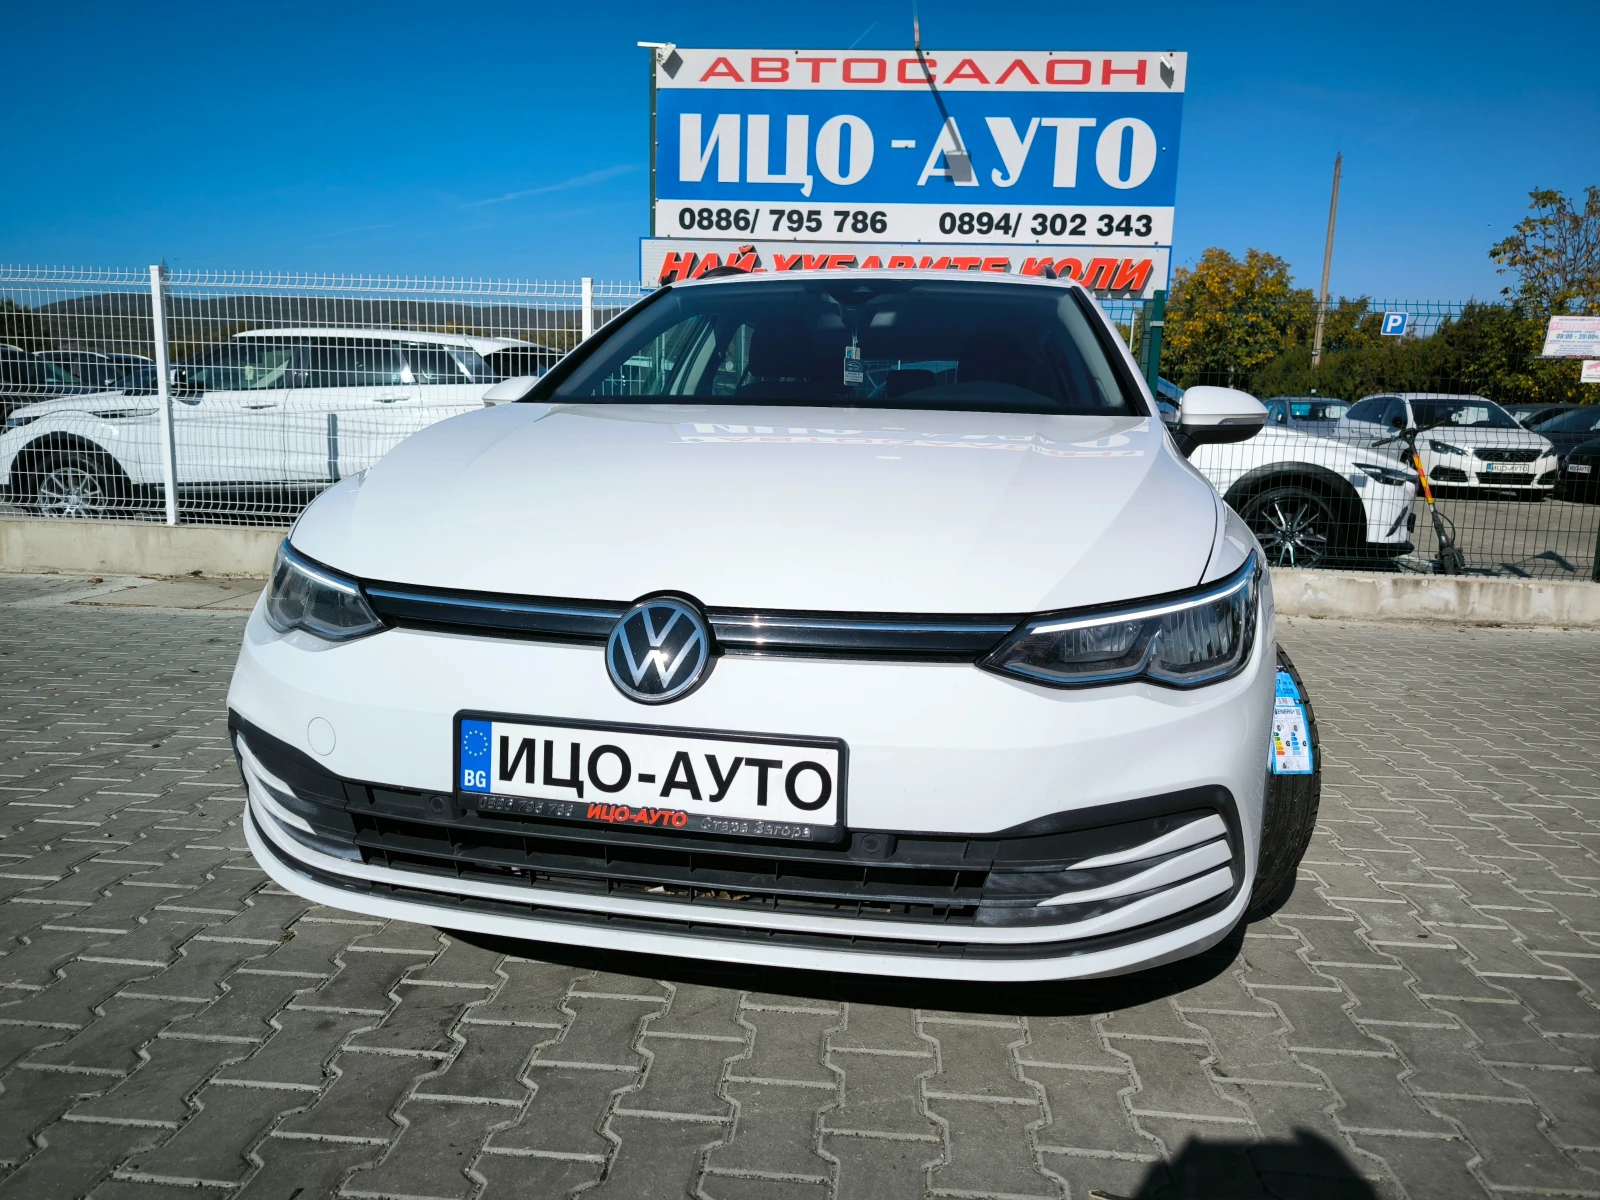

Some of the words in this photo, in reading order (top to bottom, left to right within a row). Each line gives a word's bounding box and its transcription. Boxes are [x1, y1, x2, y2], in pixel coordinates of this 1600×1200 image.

[698, 57, 1147, 85] АВТОСАЛОН
[678, 207, 760, 234] 0886/
[769, 209, 822, 232] 795
[833, 210, 888, 234] 786
[938, 211, 1022, 237] 0894/
[1030, 213, 1087, 236] 302
[1096, 214, 1153, 237] 343
[1020, 257, 1153, 290] КОЛИ
[1386, 315, 1402, 332] P
[464, 769, 486, 788] BG
[499, 735, 832, 811] ИЦО-АУТО
[587, 802, 688, 828] ИЦО-АУТО
[701, 816, 749, 834] Стара
[754, 820, 812, 839] Загора
